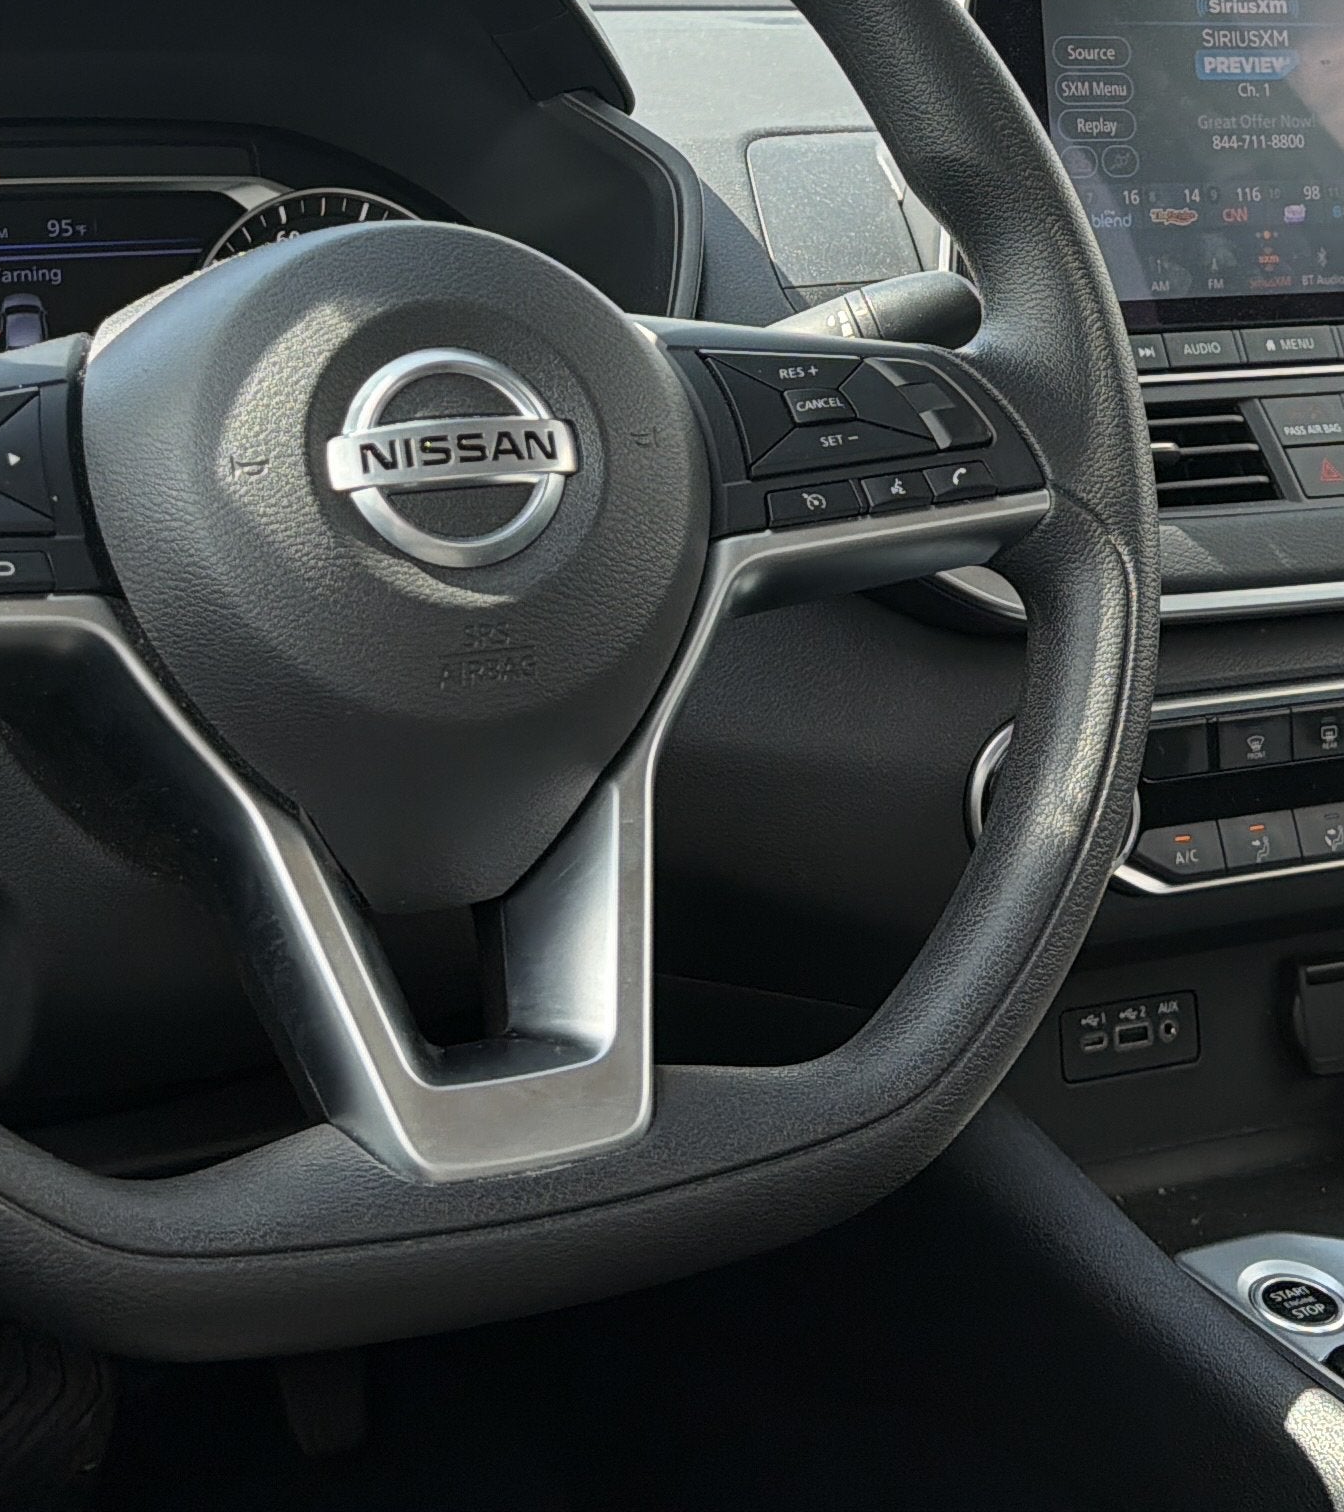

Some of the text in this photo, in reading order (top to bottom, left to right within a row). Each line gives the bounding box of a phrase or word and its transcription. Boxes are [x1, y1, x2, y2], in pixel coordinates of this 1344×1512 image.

[1201, 29, 1289, 48] SIRIUSXM
[1067, 44, 1116, 61] Source
[1203, 55, 1291, 75] PREVIEW
[1061, 81, 1127, 97] SXM Menu
[1237, 82, 1271, 98] Ch. 1
[1076, 117, 1118, 136] Replay
[1197, 113, 1317, 130] Great Offer Now!
[1212, 134, 1305, 150] 844-711-8800
[1123, 190, 1140, 205] 16
[1184, 189, 1200, 203] 14
[1236, 187, 1261, 202] 116
[1303, 186, 1320, 200] 98
[1091, 213, 1132, 229] blend
[1222, 206, 1248, 223] CNN
[1207, 278, 1224, 290] FM
[1301, 274, 1314, 287] BT
[1183, 342, 1221, 355] AUDIO
[1279, 337, 1315, 350] MENU
[778, 367, 805, 379] RES
[796, 396, 844, 412] CANCEL
[1283, 425, 1307, 436] PASS
[1323, 423, 1342, 434] BAG
[820, 434, 843, 448] SET
[359, 428, 558, 476] NISSAN
[1175, 849, 1199, 865] A/C
[1158, 1000, 1179, 1015] AUX
[1269, 1285, 1311, 1302] START
[1291, 1303, 1325, 1319] STOP
